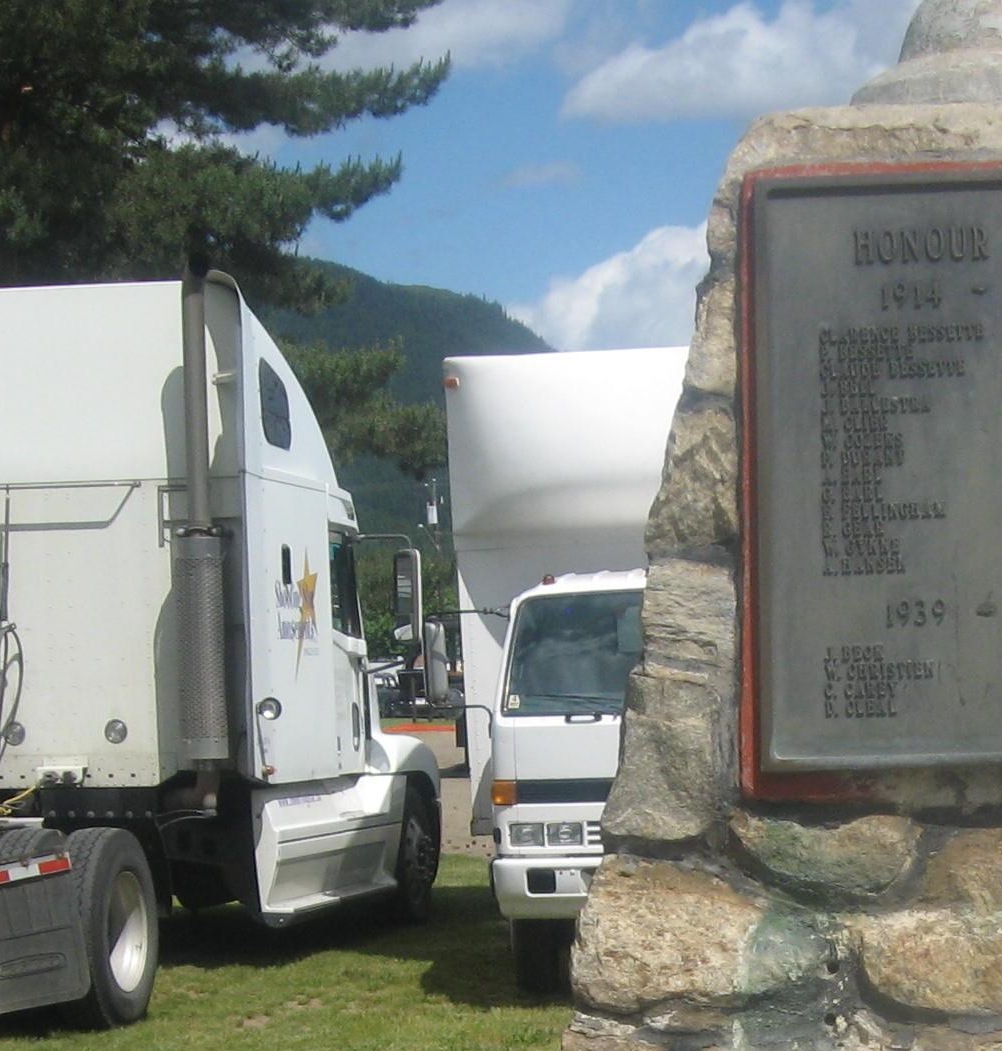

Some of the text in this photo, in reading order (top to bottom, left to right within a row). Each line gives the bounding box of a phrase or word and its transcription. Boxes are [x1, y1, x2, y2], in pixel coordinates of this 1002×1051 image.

[853, 225, 989, 266] HONOUR
[880, 283, 943, 311] 1914
[884, 599, 946, 628] 1939
